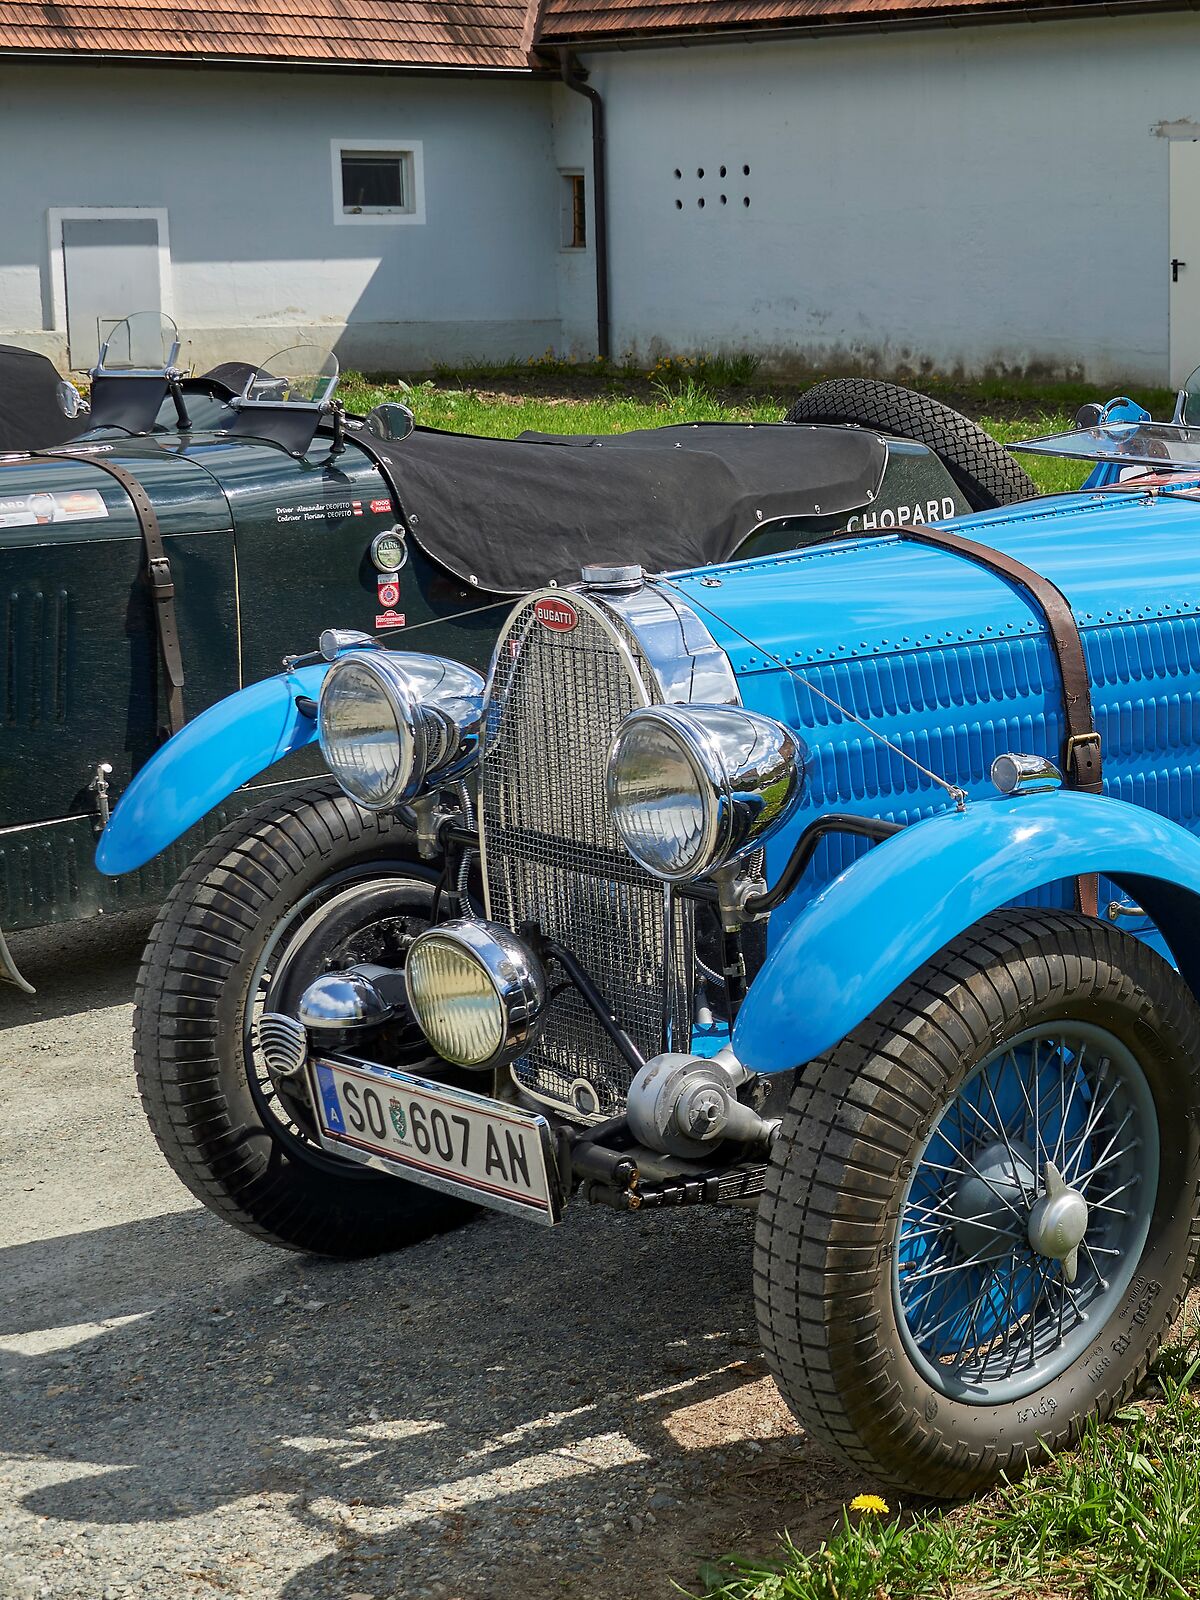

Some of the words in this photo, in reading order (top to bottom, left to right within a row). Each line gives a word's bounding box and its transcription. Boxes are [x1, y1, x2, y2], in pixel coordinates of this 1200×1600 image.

[847, 497, 955, 532] CHOPARD
[537, 607, 572, 625] BUGATTI
[330, 1107, 340, 1123] A
[342, 1081, 387, 1140] SO
[409, 1101, 470, 1168] 607
[485, 1123, 531, 1188] AN
